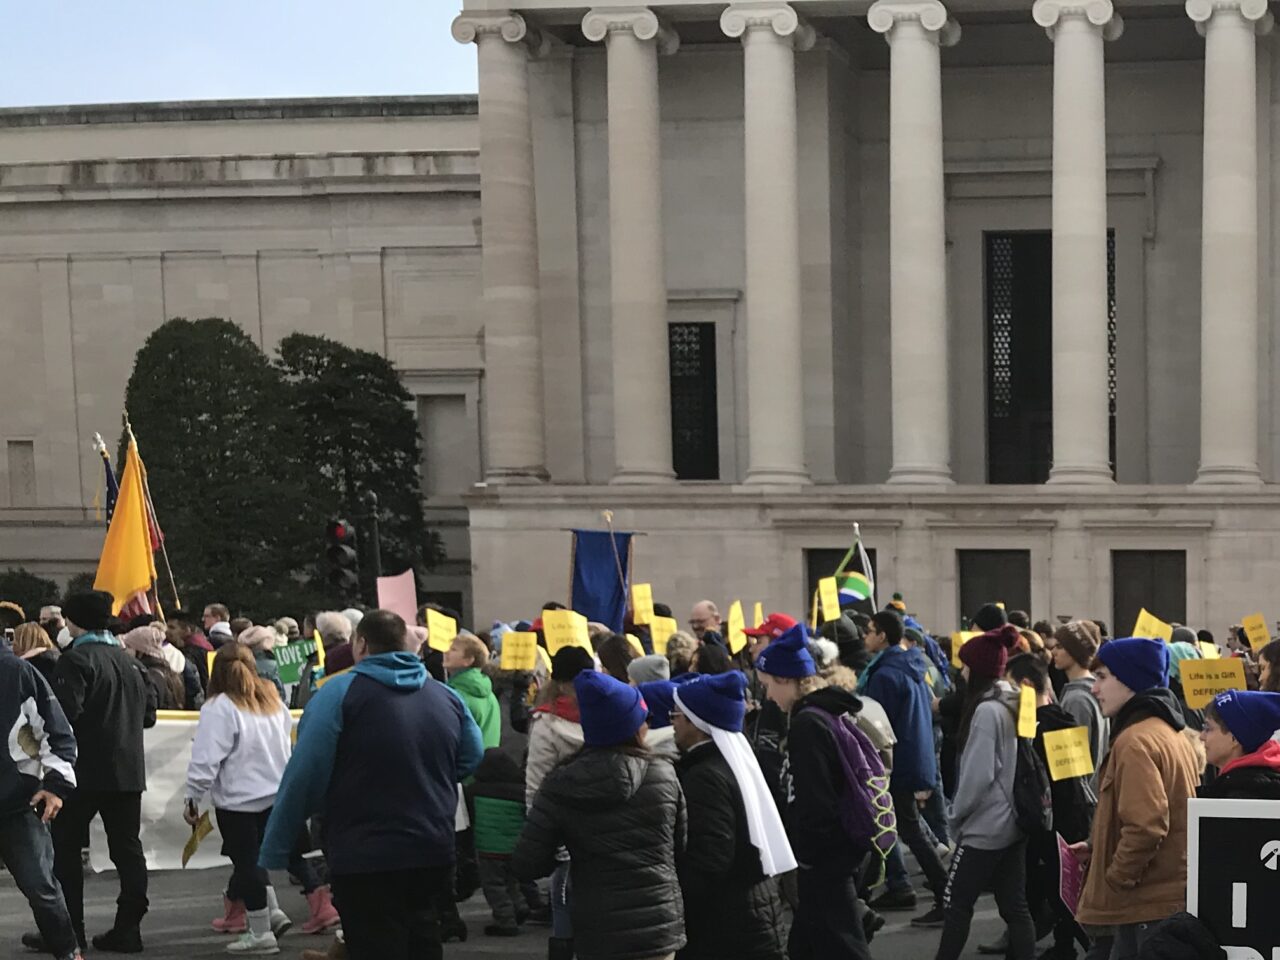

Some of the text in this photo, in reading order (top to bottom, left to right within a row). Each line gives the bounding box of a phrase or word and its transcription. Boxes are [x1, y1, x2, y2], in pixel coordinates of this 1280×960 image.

[275, 645, 303, 666] LOVE
[1189, 672, 1204, 680] Life
[1206, 672, 1212, 680] is
[1221, 671, 1236, 679] Gift
[1231, 882, 1248, 928] I
